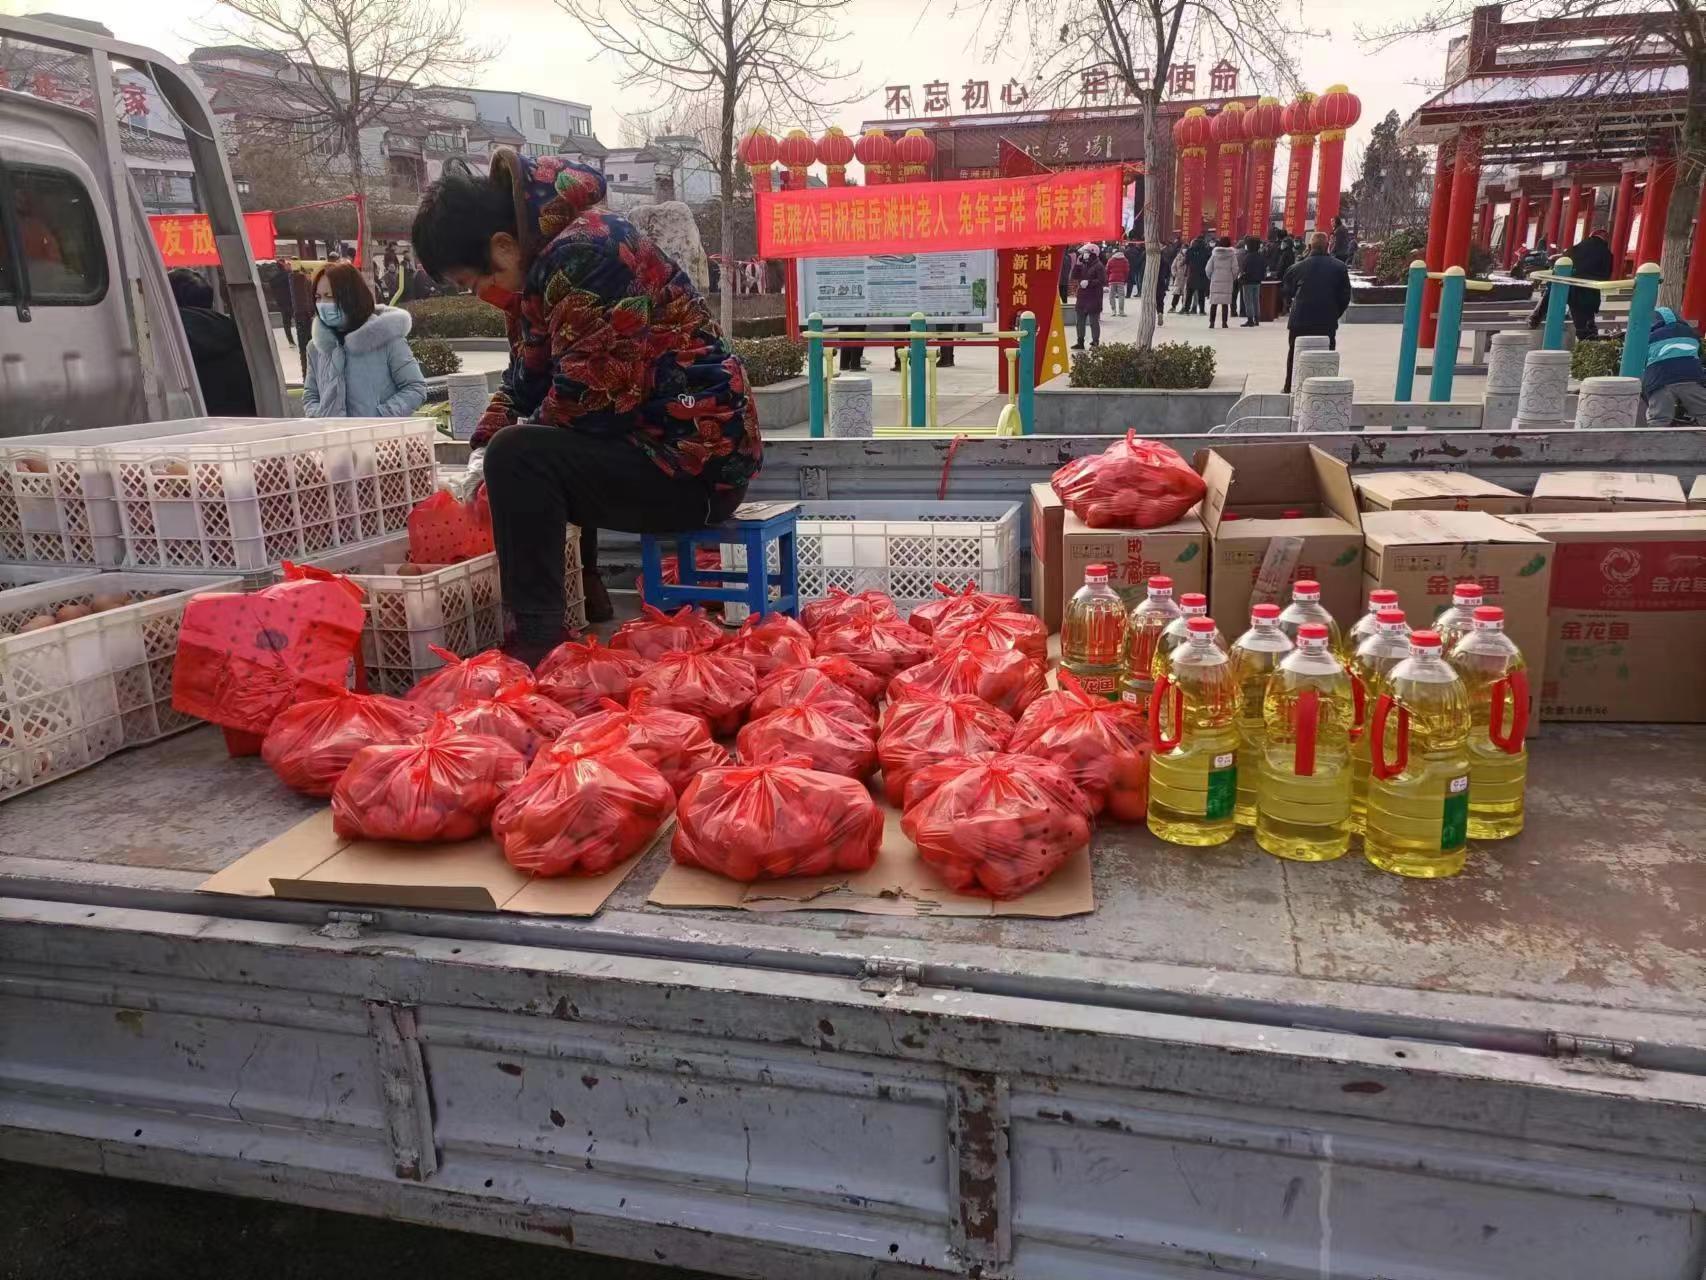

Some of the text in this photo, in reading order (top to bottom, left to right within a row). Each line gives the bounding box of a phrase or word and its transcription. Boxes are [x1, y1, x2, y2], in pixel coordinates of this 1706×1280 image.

[885, 58, 1240, 114] 不忘初心 牢记使命
[959, 187, 1026, 236] 兔年吉祥
[1036, 181, 1106, 231] 福寿安康
[160, 219, 217, 256] 发放
[1011, 246, 1028, 306] 新风尚
[1651, 577, 1706, 593] 金龙鱼
[1560, 621, 1631, 640] 金龙鱼
